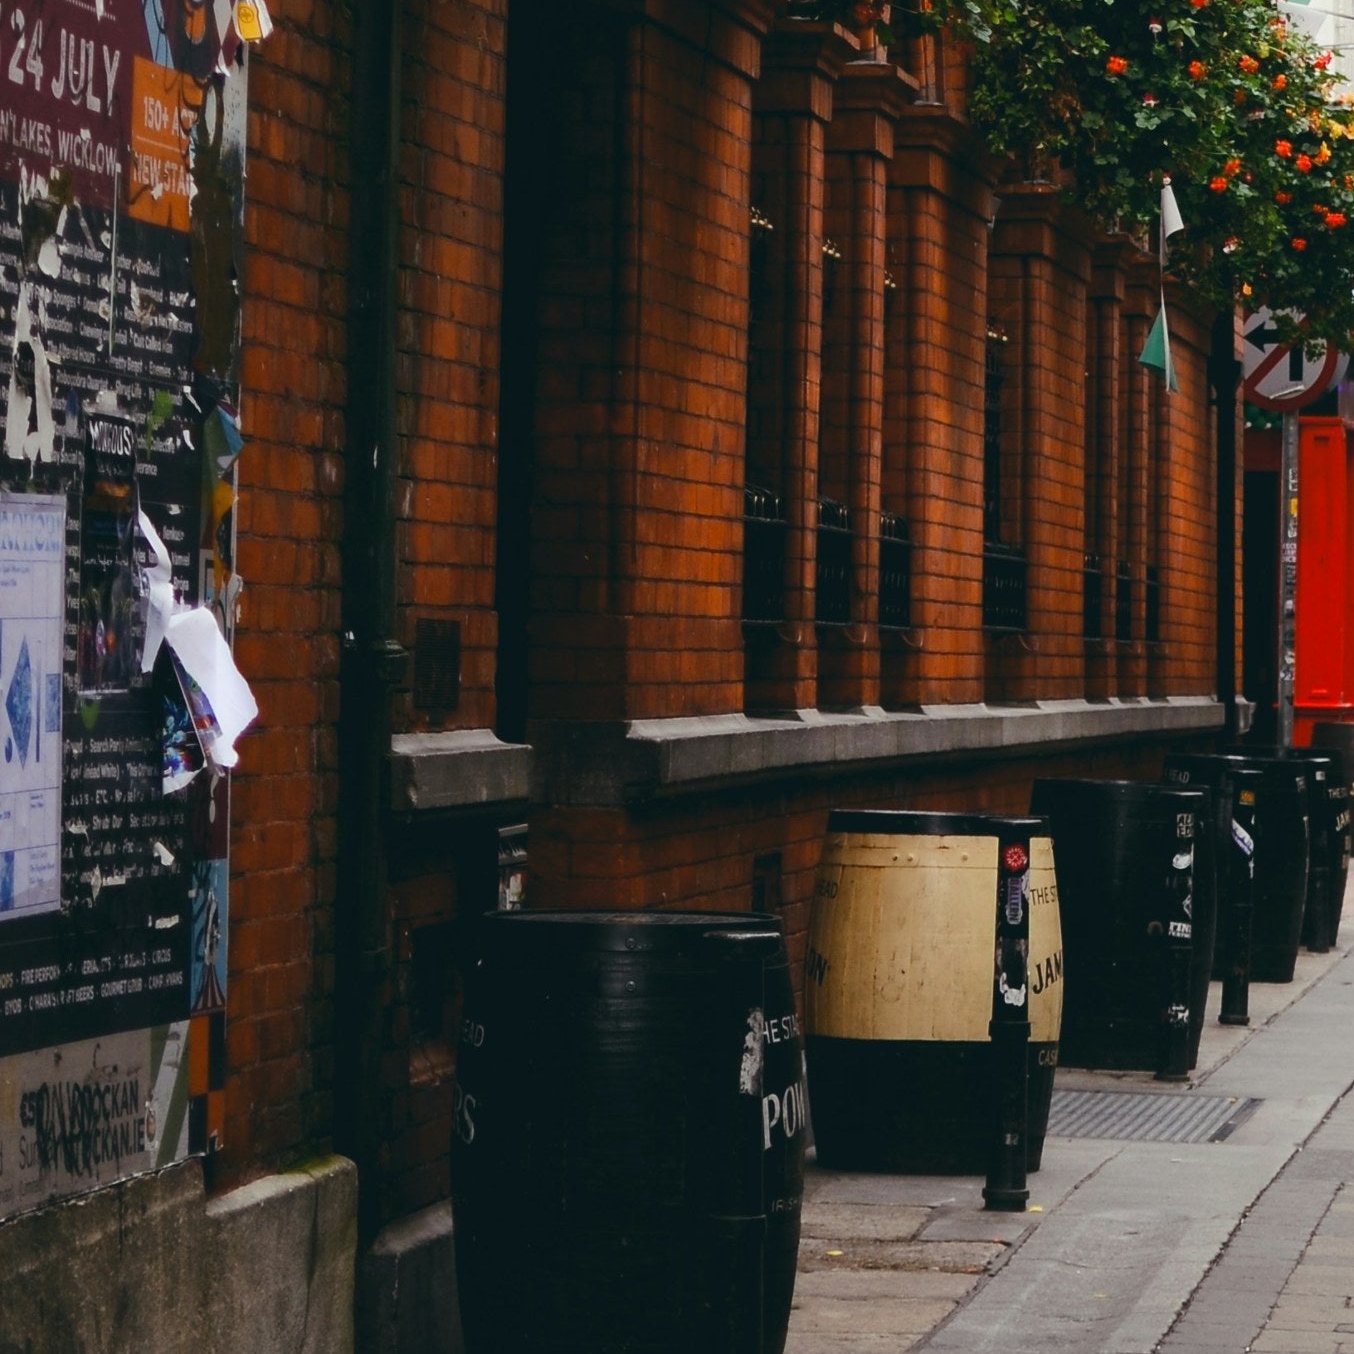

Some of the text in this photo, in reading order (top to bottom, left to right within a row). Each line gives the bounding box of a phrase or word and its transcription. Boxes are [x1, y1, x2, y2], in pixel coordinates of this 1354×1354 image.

[8, 8, 120, 117] 24 JULY
[58, 129, 118, 177] WICKLOW
